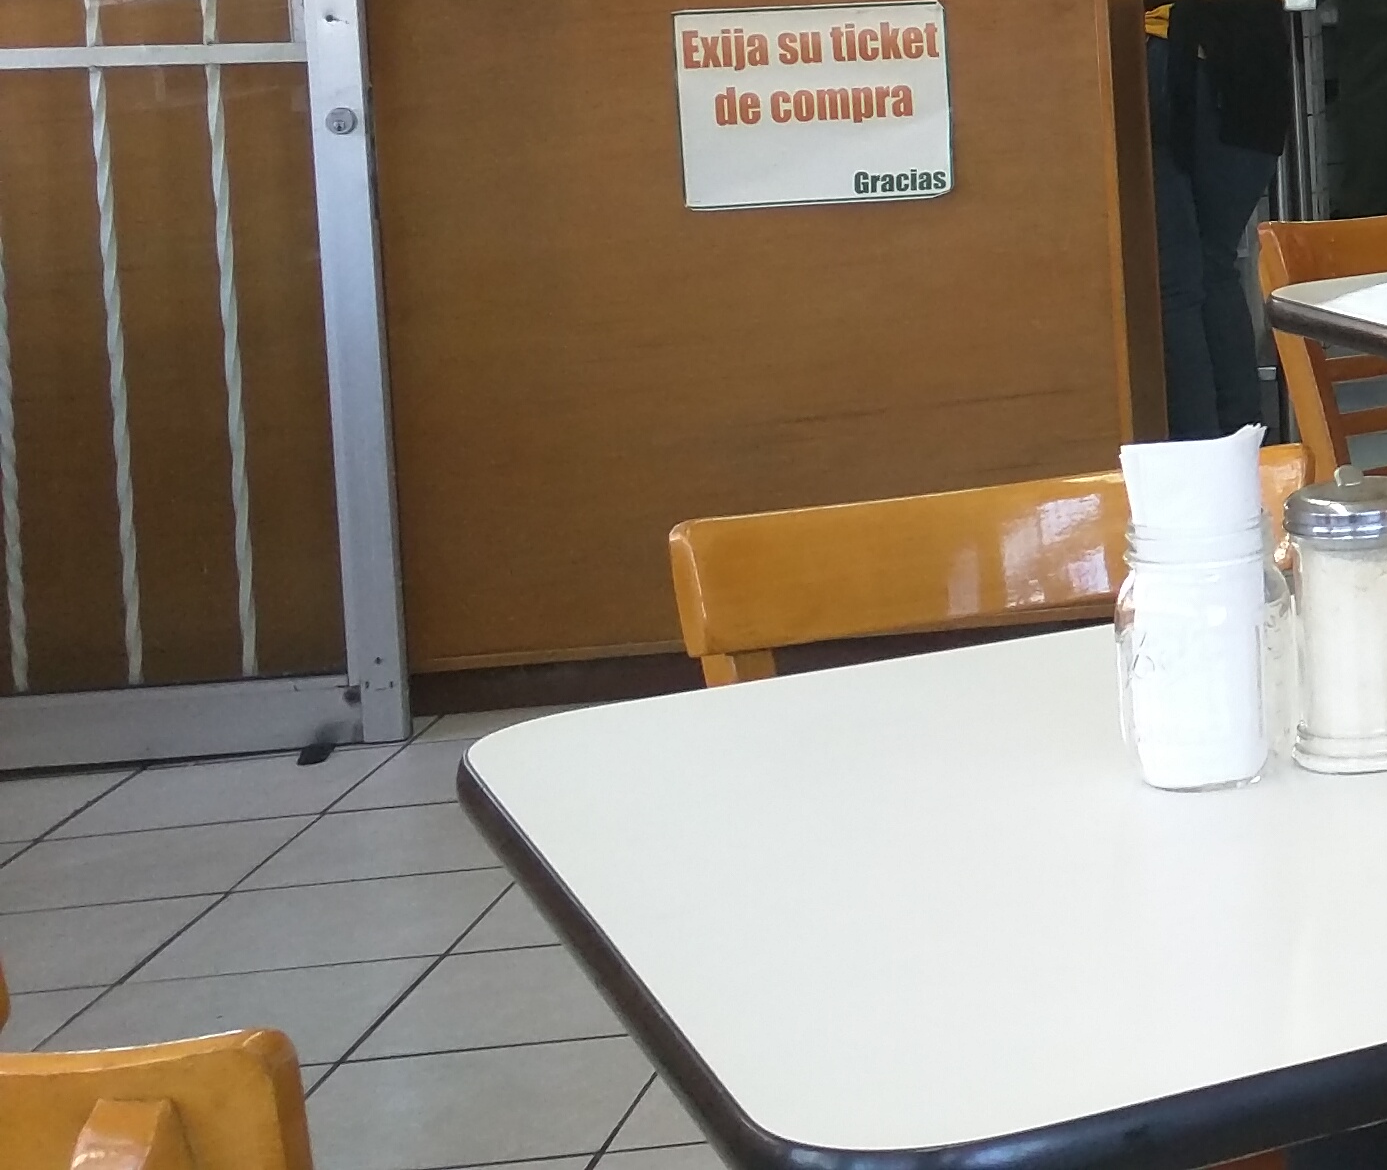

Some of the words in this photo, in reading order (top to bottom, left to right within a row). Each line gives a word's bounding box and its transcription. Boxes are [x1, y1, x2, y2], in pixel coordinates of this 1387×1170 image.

[681, 28, 770, 71] Exija
[777, 31, 823, 65] su
[830, 22, 940, 62] ticket
[714, 87, 762, 126] de
[770, 84, 914, 123] compra
[853, 169, 947, 194] Gracias
